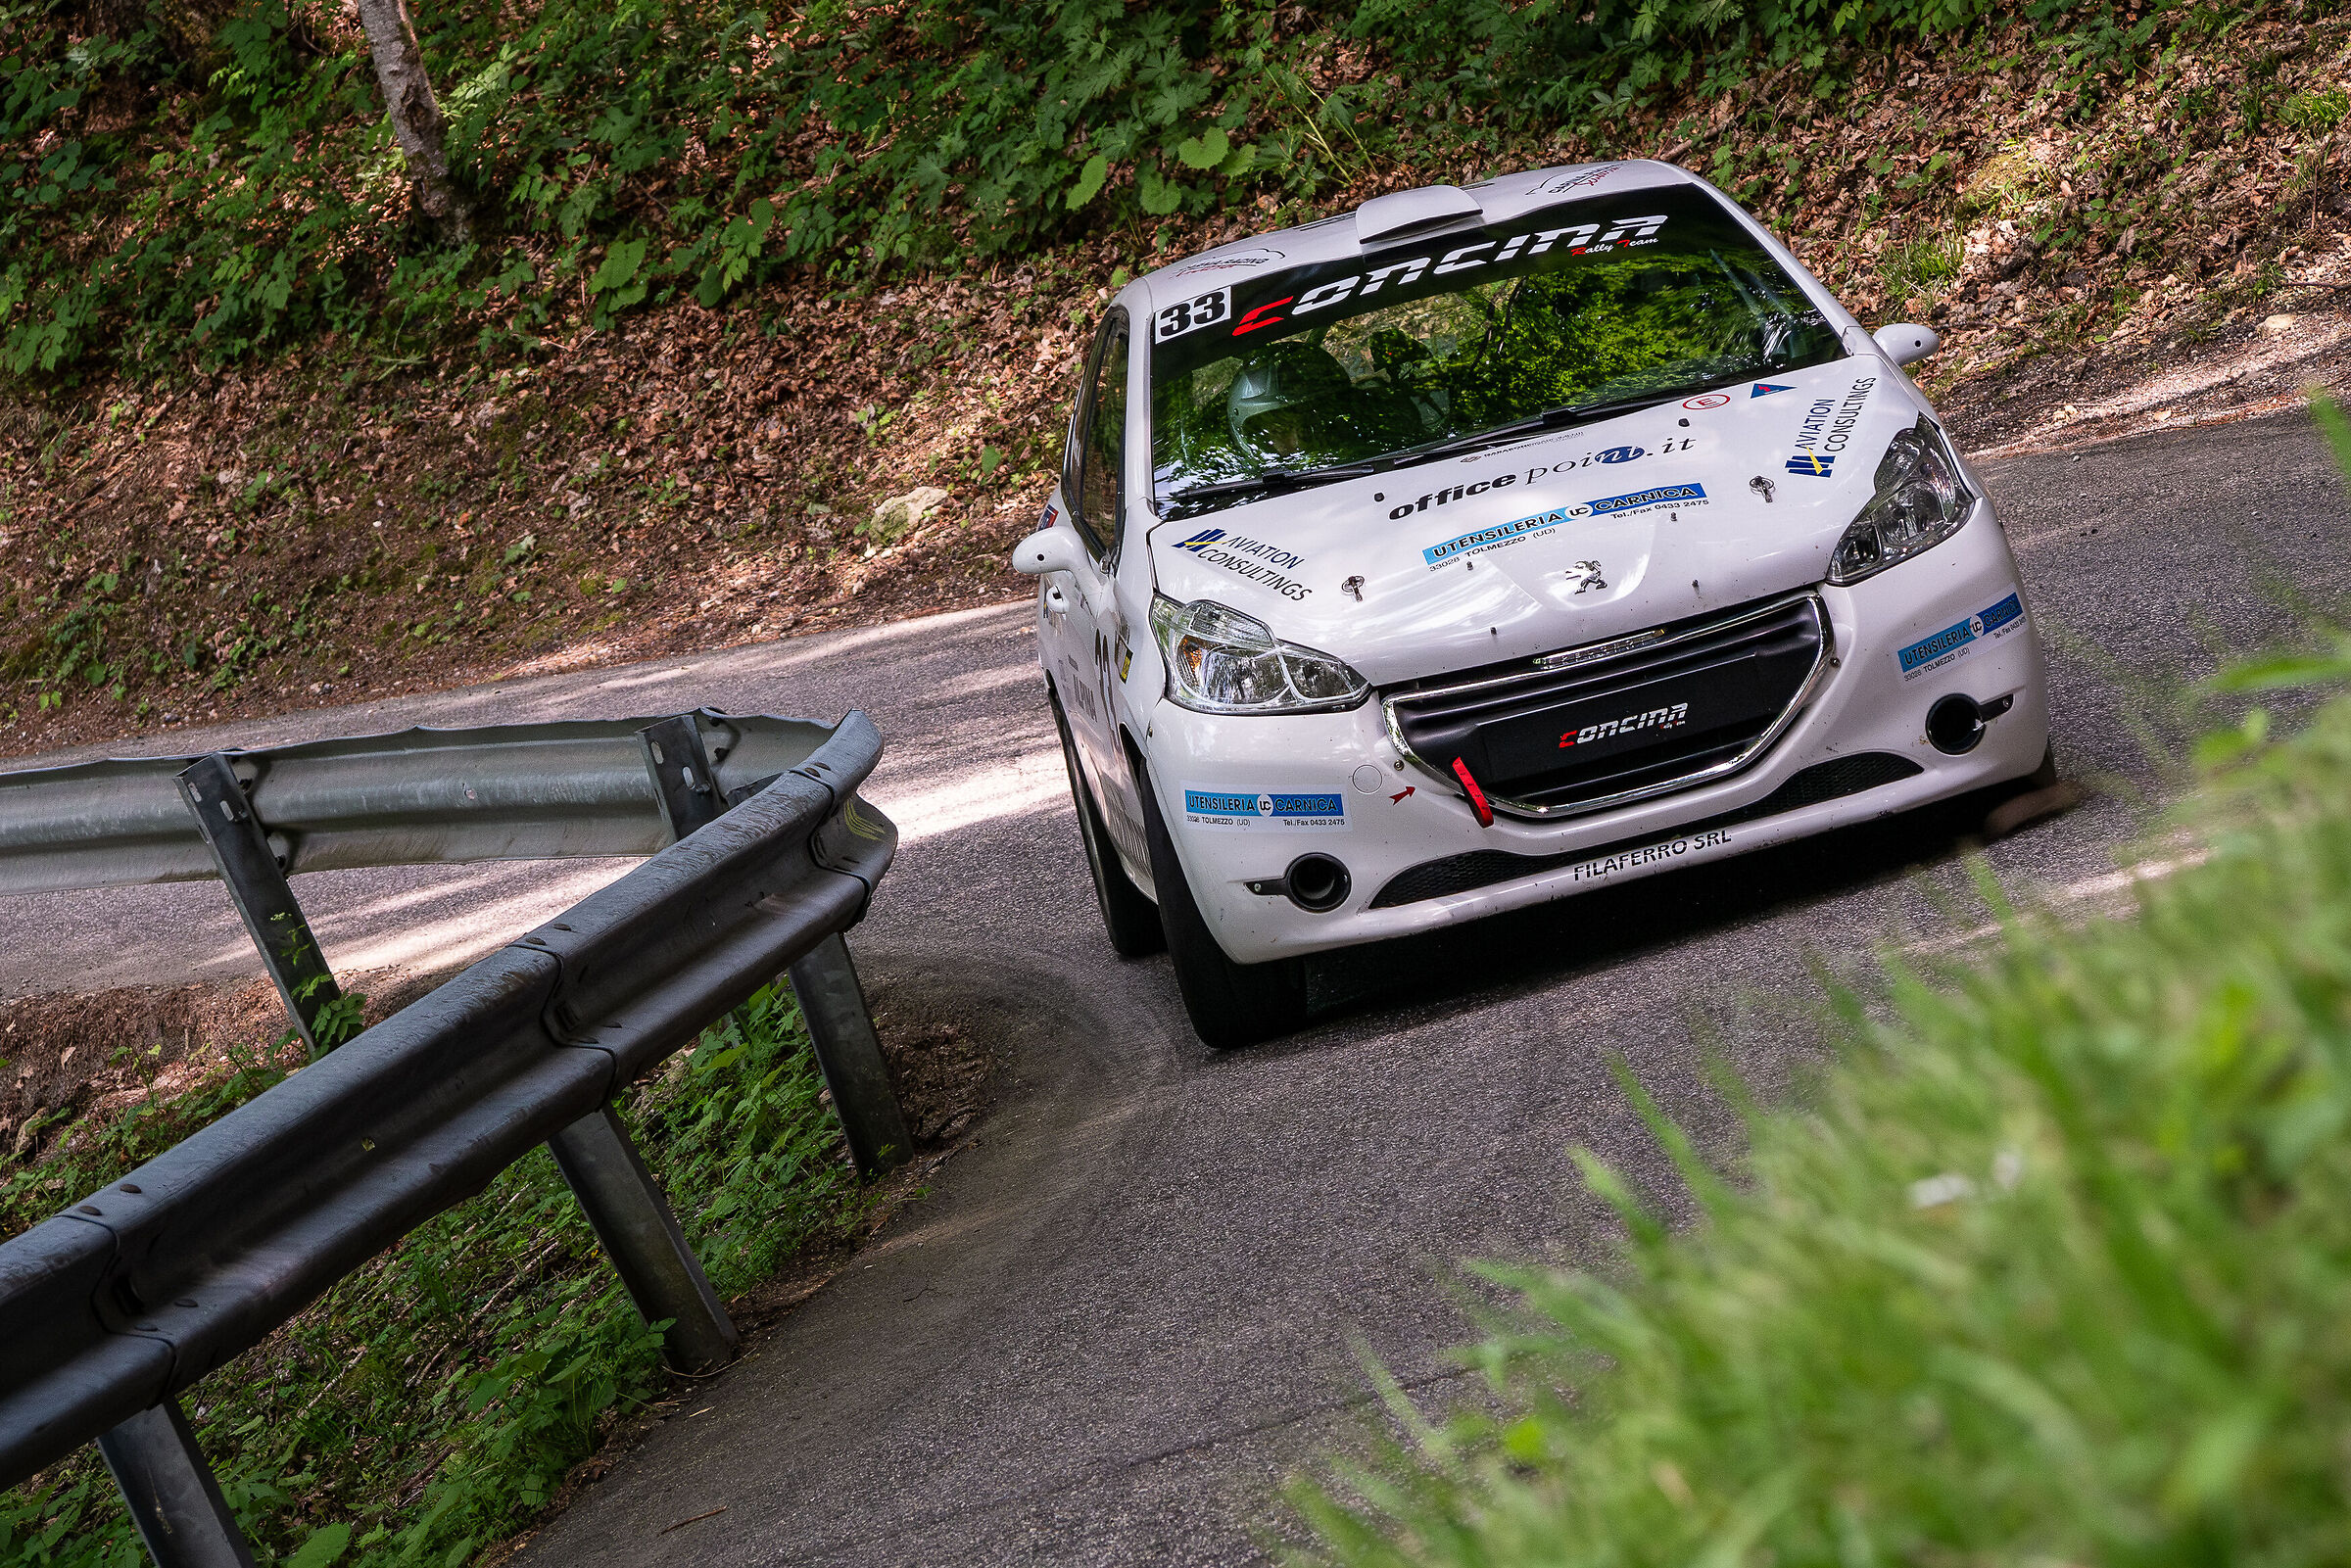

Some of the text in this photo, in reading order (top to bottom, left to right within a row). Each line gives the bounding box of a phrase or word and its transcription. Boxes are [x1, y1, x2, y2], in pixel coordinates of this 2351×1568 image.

[1571, 237, 1658, 257] Rally Team
[1160, 291, 1225, 337] 33
[1795, 399, 1836, 450] AVIATION
[1824, 377, 1876, 451] CONSULTINGS
[1389, 474, 1516, 520] office
[1610, 507, 1652, 519] Tel./Fax
[1434, 512, 1564, 557] UTENSILERIA
[1595, 487, 1697, 511] CARNICA
[1222, 536, 1305, 569] AVIATION
[1429, 528, 1556, 572] 33028 TOLMEZZO (UD)
[1197, 548, 1312, 600] CONSULTINGS
[1904, 627, 1970, 665] UTENSILERIA
[1924, 653, 1955, 673] TOLMEZZO
[1188, 794, 1256, 811] UTENSILERIA
[1274, 798, 1337, 812] CARNICA
[1574, 831, 1732, 881] FILAFERRO SRL
